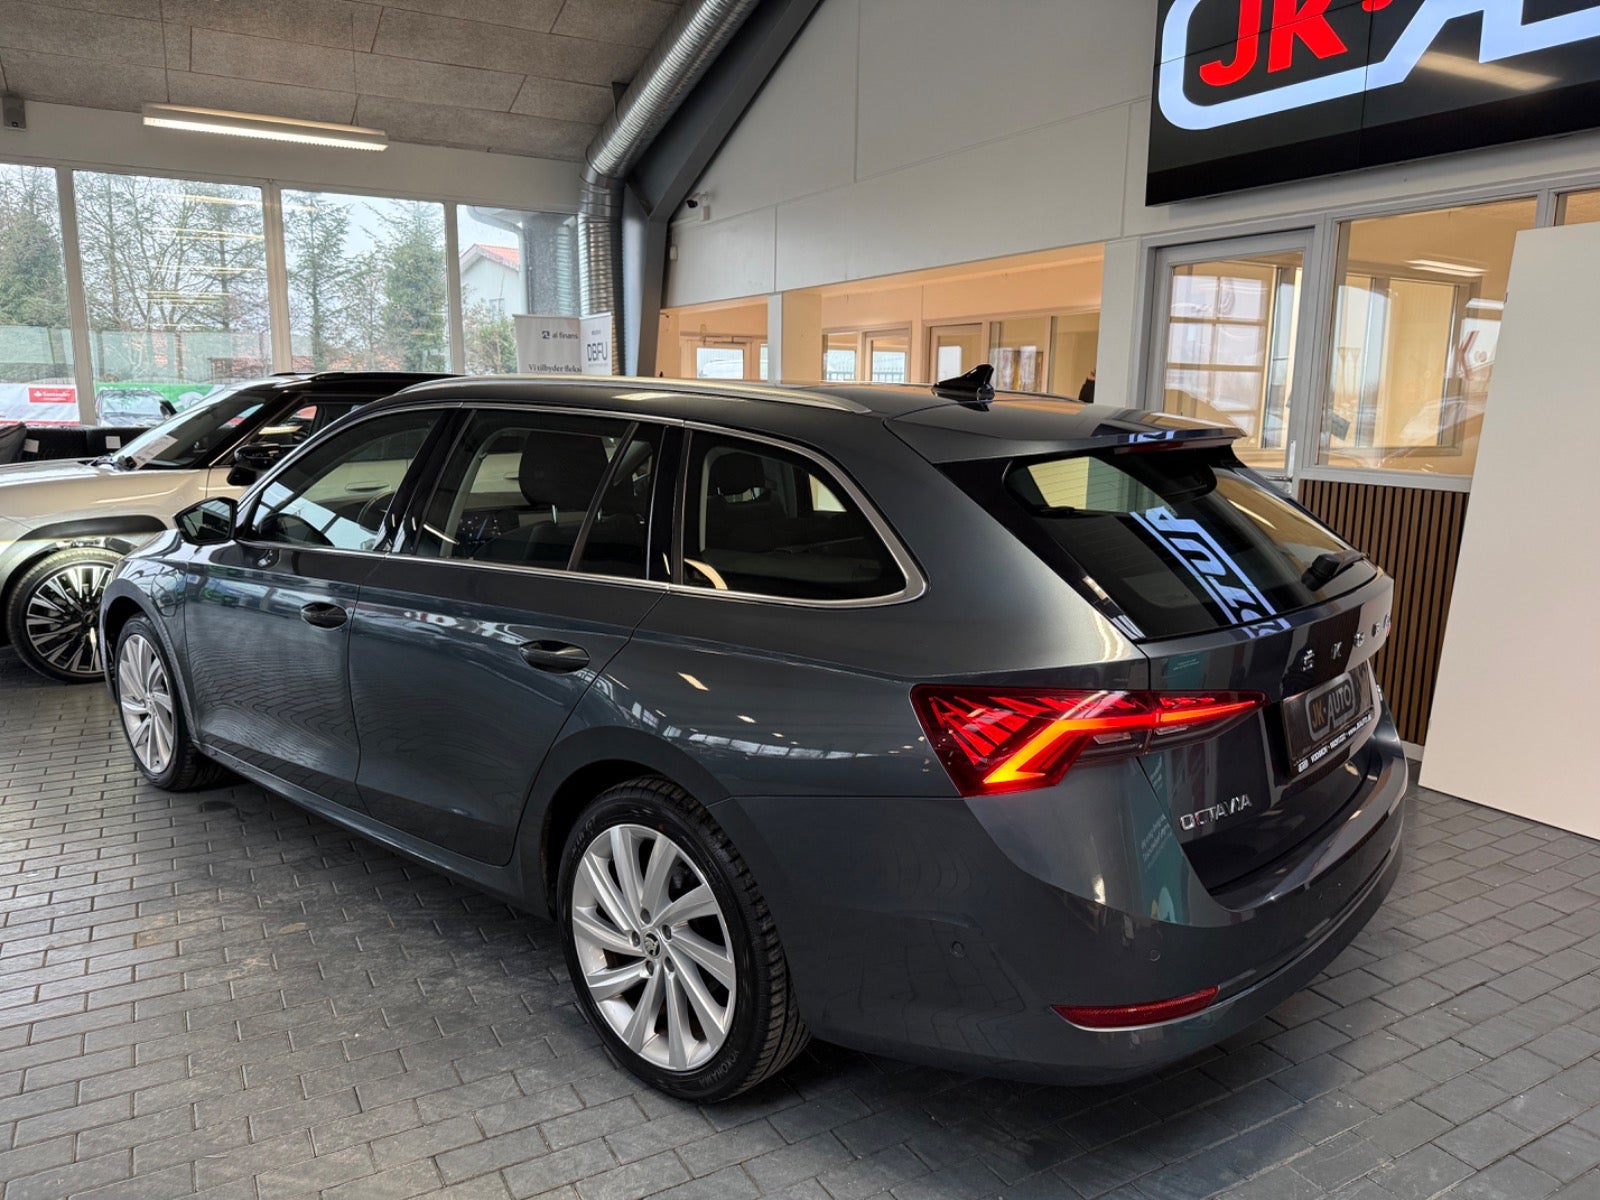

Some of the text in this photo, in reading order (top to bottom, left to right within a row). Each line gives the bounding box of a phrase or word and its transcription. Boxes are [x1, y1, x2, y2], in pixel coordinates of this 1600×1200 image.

[587, 341, 608, 361] DBFU
[528, 363, 536, 371] Vi
[537, 363, 563, 373] tilbyder
[1180, 793, 1252, 831] OCTAVIA
